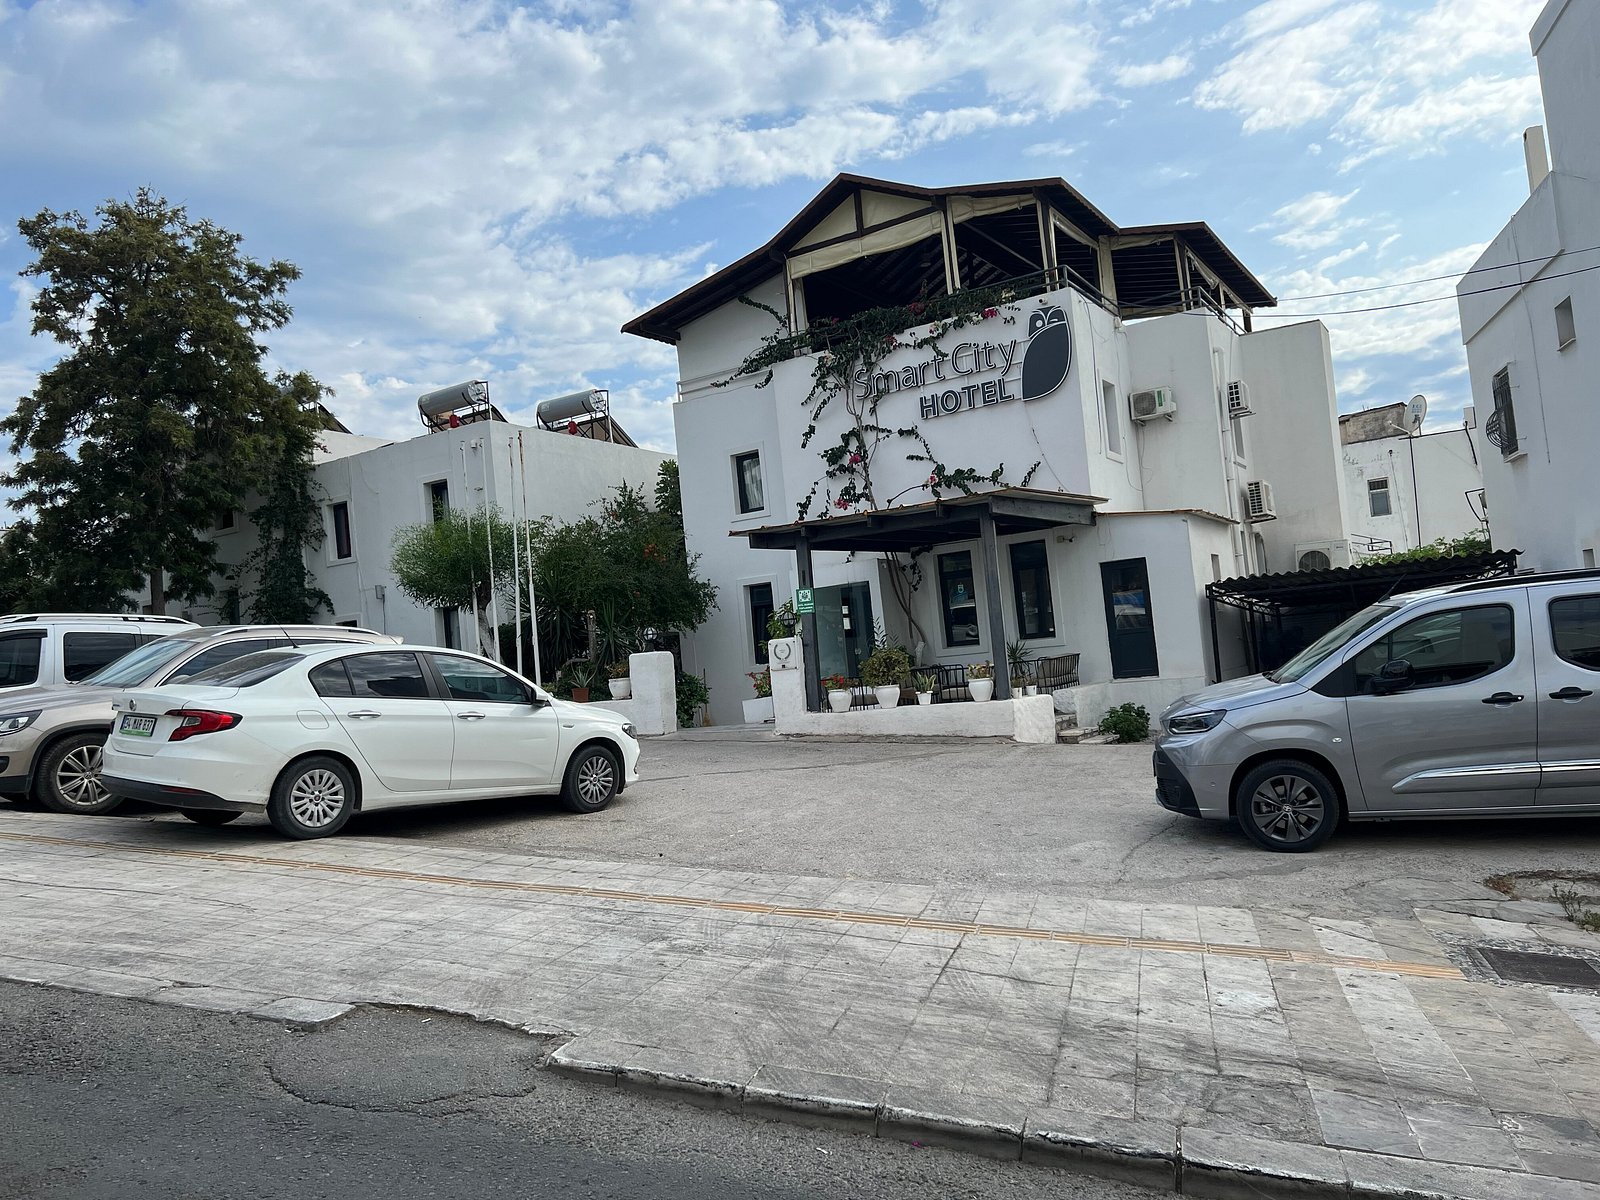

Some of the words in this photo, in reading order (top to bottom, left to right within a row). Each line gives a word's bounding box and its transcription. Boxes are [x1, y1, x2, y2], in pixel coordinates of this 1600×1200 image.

[854, 354, 946, 399] Smart
[951, 339, 1017, 376] City
[919, 377, 1015, 420] HOTEL
